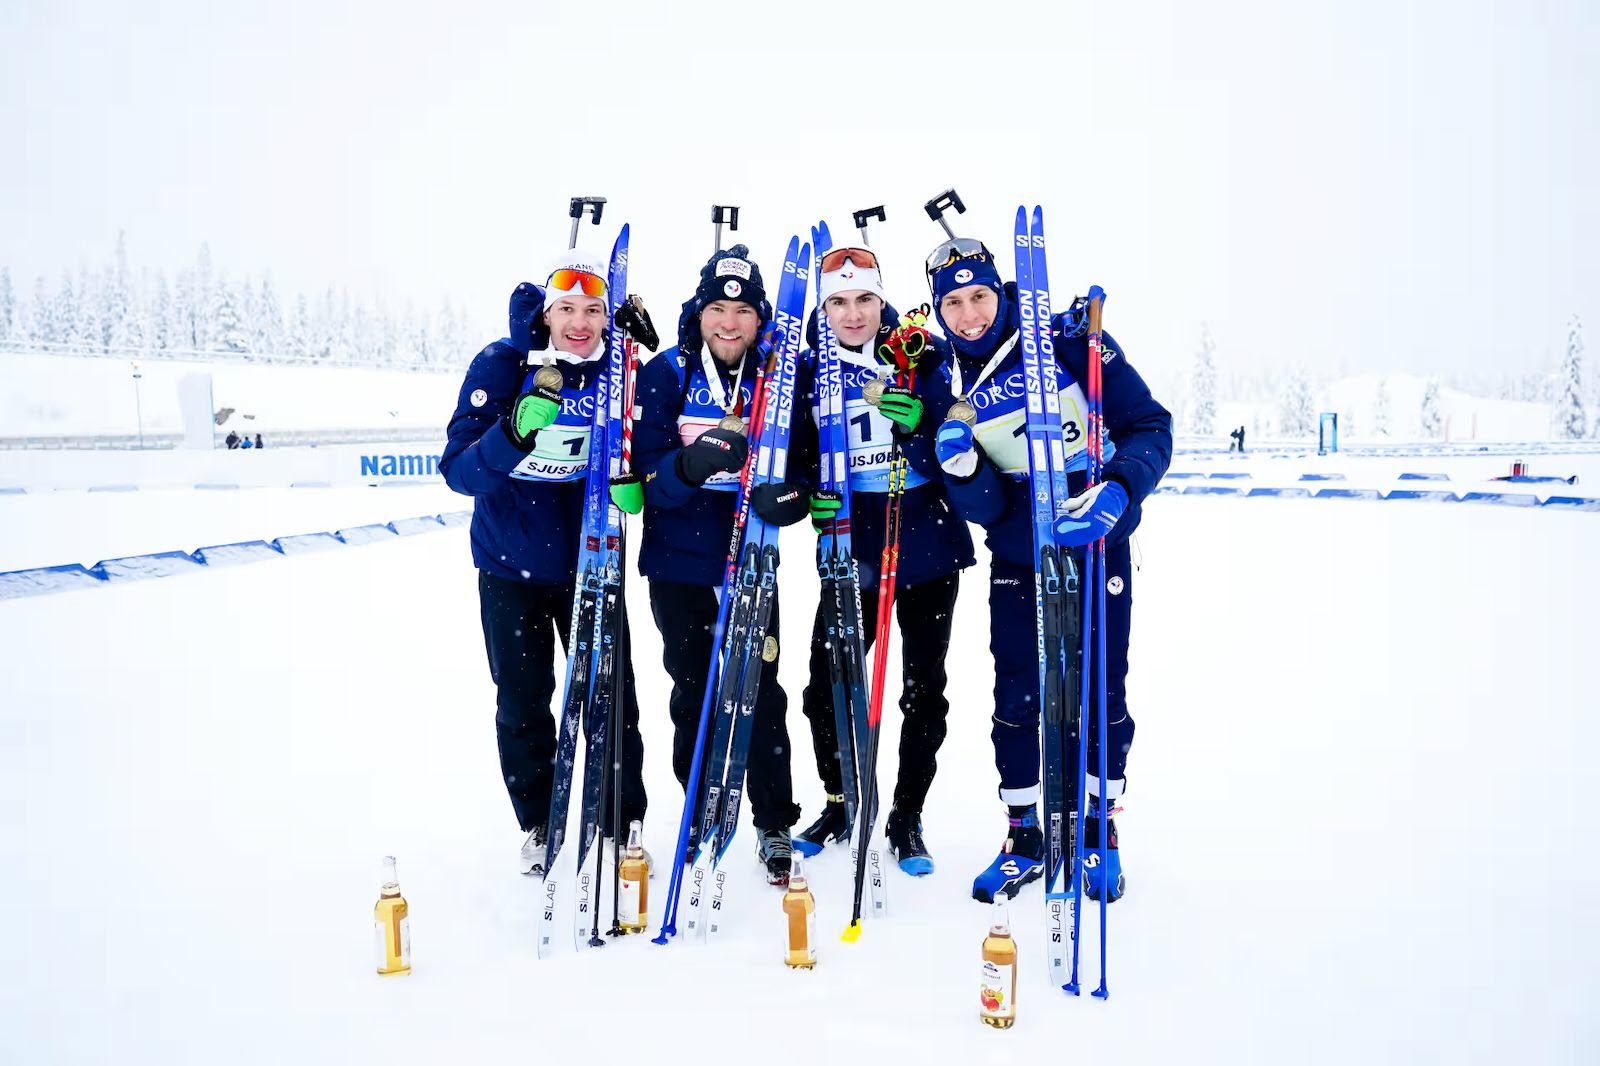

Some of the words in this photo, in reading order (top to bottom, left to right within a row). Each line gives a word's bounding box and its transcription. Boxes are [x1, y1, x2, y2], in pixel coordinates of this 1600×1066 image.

[610, 302, 625, 401] SALOM
[781, 315, 802, 411] SALOMON
[1020, 289, 1041, 394] SALOMON
[1036, 289, 1059, 394] SALOMON
[360, 454, 441, 476] Namm
[527, 461, 589, 475] SJUSJØ
[562, 436, 585, 456] 1
[851, 411, 872, 442] 1
[568, 573, 584, 656] SALOMON
[851, 558, 865, 641] SALOMON
[1034, 572, 1047, 663] SALOMON
